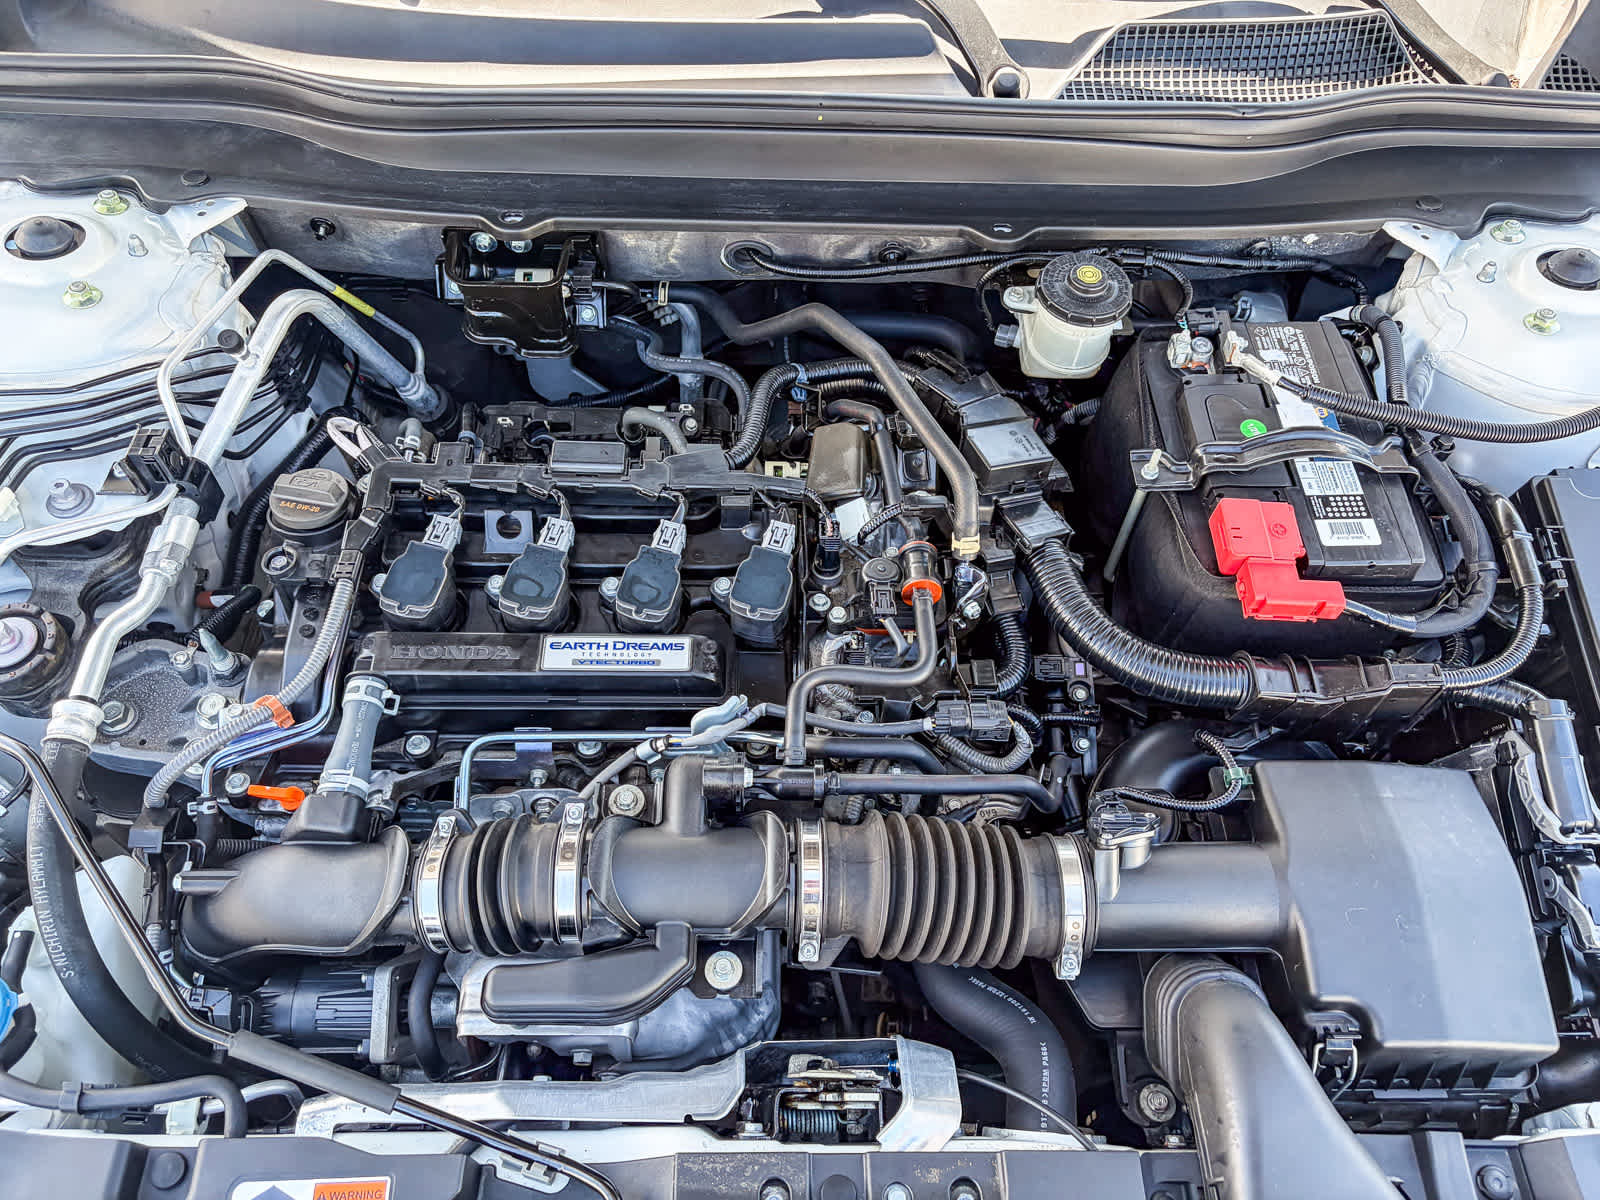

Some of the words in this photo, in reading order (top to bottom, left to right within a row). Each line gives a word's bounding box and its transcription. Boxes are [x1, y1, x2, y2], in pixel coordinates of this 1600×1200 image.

[280, 500, 297, 509] SAE
[296, 503, 321, 513] 0W-20
[549, 641, 609, 651] EARTH
[612, 640, 686, 651] DREAMS
[391, 645, 521, 660] HONDA
[31, 844, 50, 906] HYLAMMIT
[329, 1188, 384, 1200] WARNING
